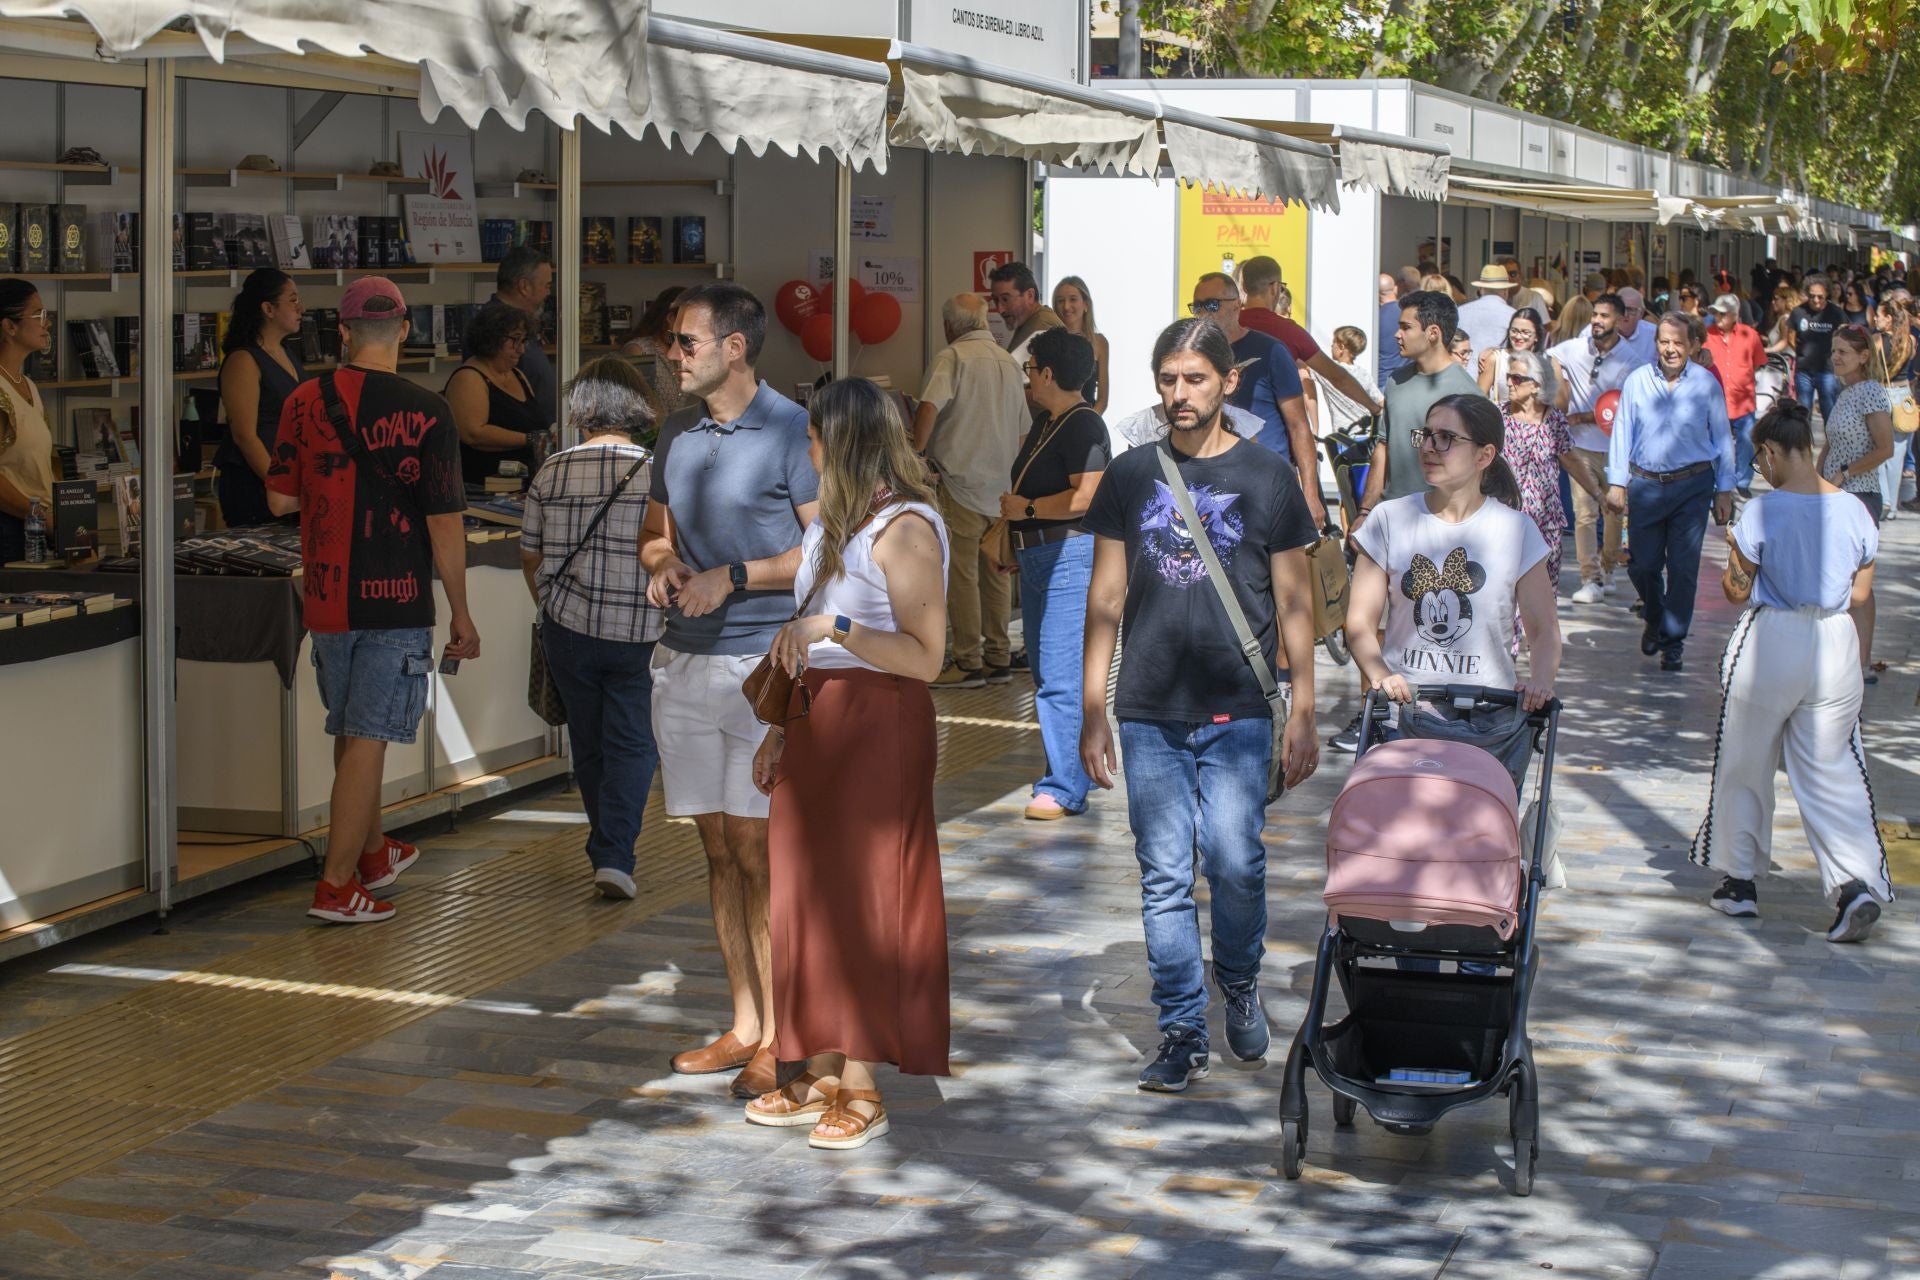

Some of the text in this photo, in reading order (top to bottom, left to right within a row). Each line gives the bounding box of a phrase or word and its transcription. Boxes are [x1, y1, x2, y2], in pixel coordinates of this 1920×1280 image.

[952, 8, 976, 28] CANTOS
[976, 13, 984, 30] DE
[1015, 21, 1031, 39] LIBRO
[1031, 25, 1044, 41] AZUL
[412, 211, 473, 231] Región de Murcia
[1242, 206, 1283, 214] MURCIA
[1216, 224, 1271, 243] PALIN
[874, 271, 904, 286] 10%
[361, 410, 437, 451] LOYALTY
[360, 571, 418, 604] rough
[1400, 648, 1480, 674] MINNIE
